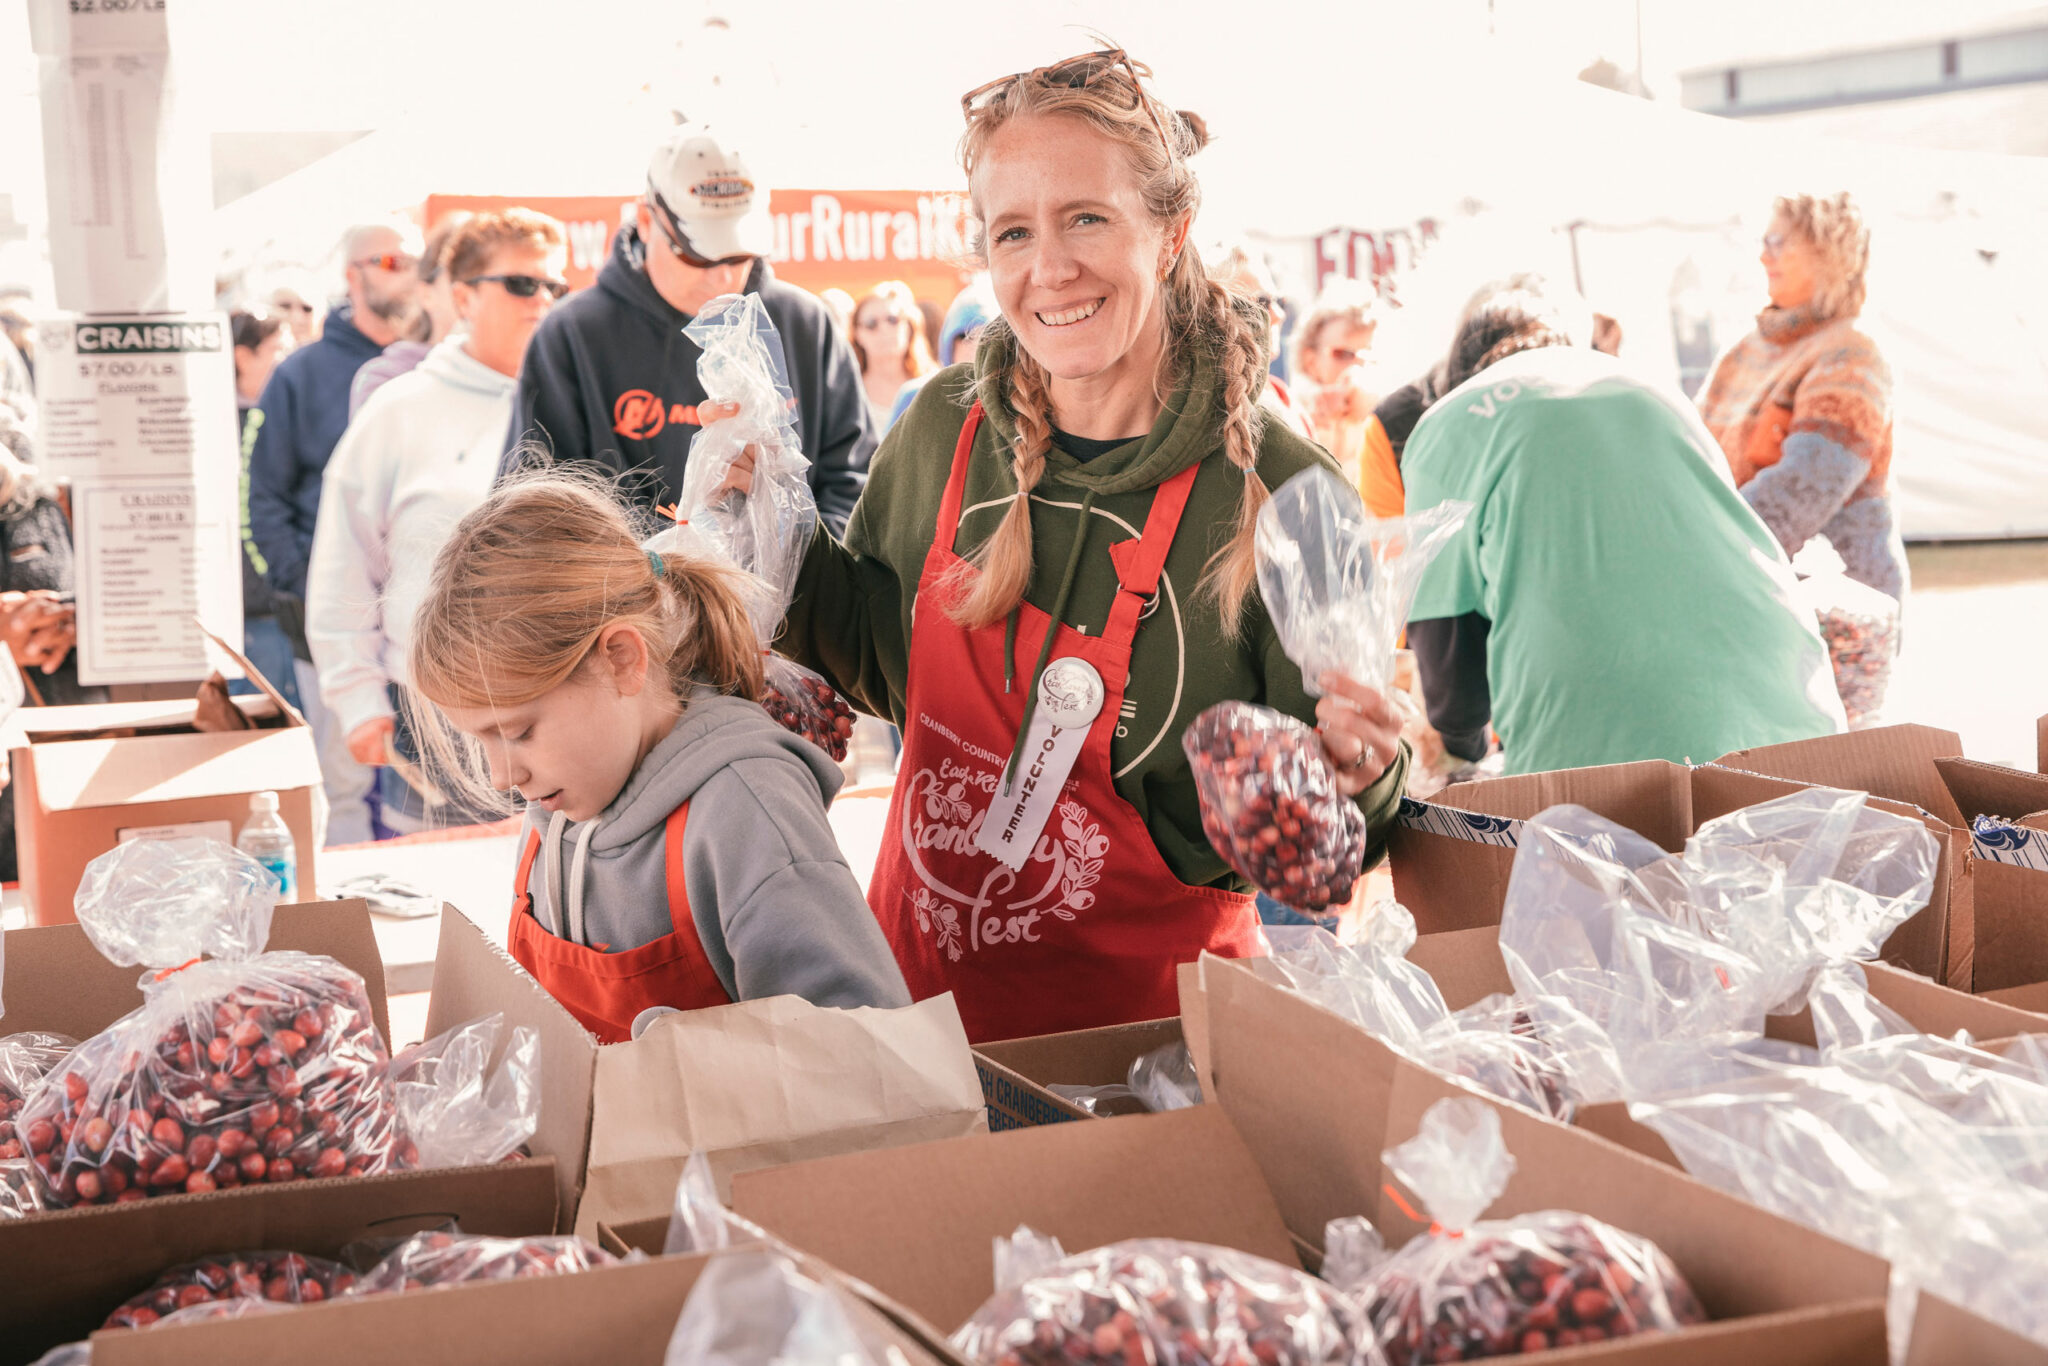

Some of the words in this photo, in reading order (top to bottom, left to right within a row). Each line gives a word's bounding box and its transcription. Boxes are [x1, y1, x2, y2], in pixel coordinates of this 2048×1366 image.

[77, 326, 220, 350] CRAISINS
[920, 713, 961, 747] CRANBERRY
[962, 741, 1006, 769] COUNTRY
[939, 757, 974, 787] Eage
[1001, 724, 1062, 843] VOLUNTEER
[903, 767, 1066, 911] Cranby
